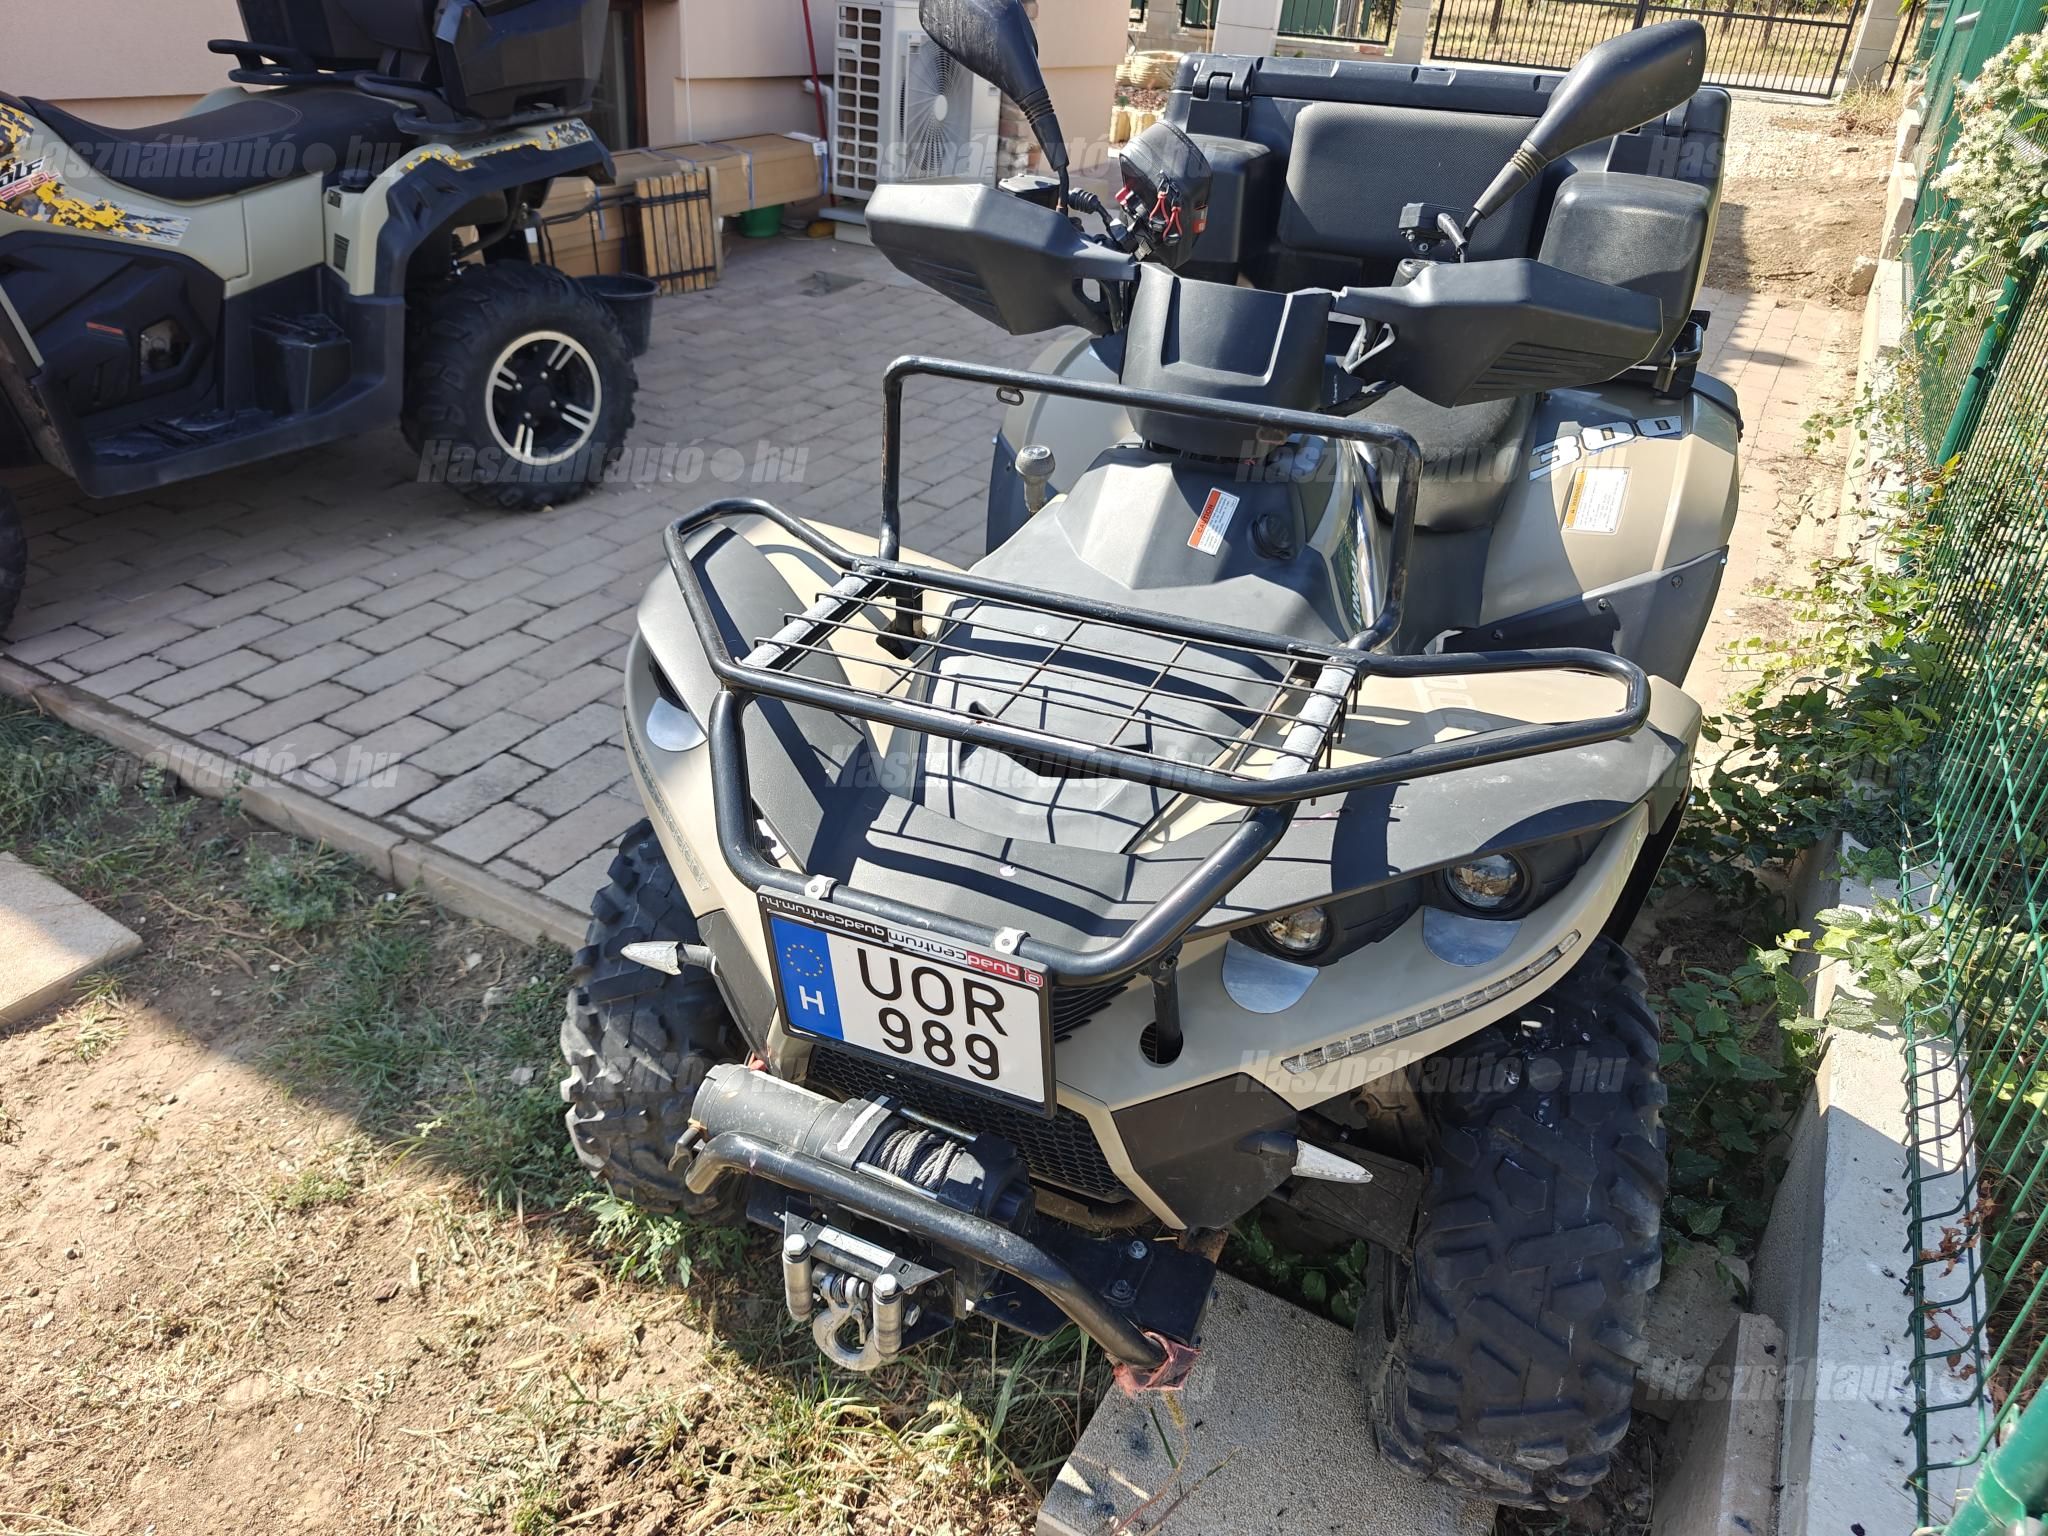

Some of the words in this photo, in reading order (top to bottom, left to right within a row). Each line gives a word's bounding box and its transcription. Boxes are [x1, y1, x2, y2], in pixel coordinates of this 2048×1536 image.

[1197, 503, 1214, 533] CAUTION
[760, 895, 884, 936] quadcentrum.hu
[889, 929, 1019, 977] quadcentrum
[798, 984, 826, 1016] H
[857, 947, 1009, 1037] UOR
[877, 1006, 1000, 1081] 989
